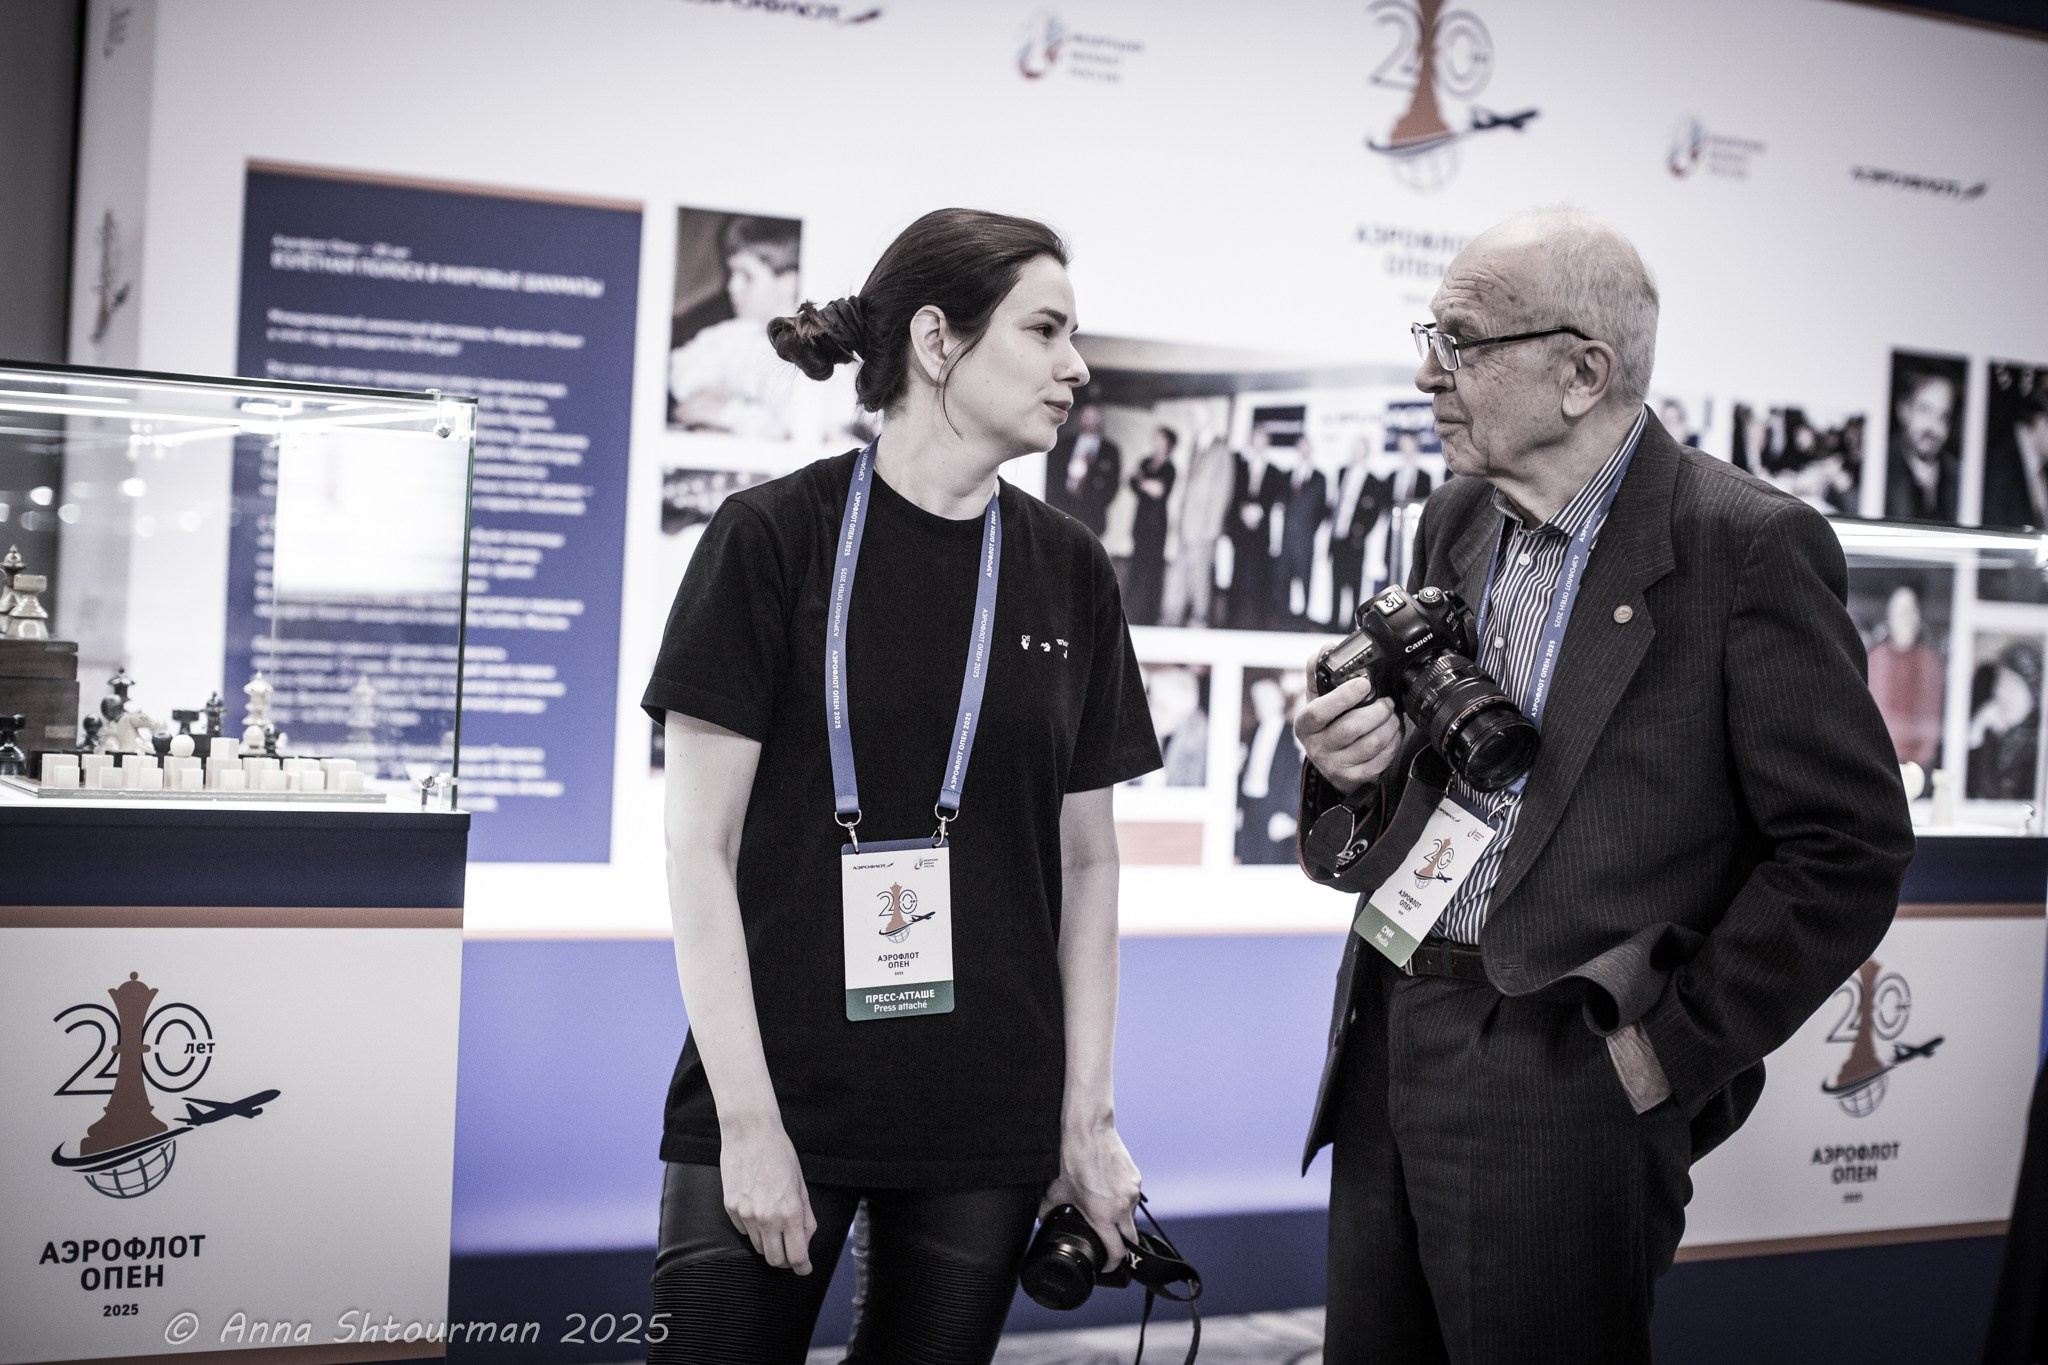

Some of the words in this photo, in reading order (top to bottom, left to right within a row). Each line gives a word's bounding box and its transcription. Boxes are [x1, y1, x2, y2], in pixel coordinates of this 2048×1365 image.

[1354, 222, 1471, 253] АЭРОФЛО
[833, 602, 842, 637] АЭРОФЛОТ
[840, 567, 848, 583] 2025
[979, 608, 988, 643] АЭРОФЛОТ
[1404, 632, 1434, 653] Canon
[1531, 679, 1546, 718] АЭРОФЛОТ
[1540, 658, 1551, 679] ОПЕН
[1546, 639, 1556, 658] 2025
[834, 711, 842, 729] 2025
[963, 712, 972, 730] 2025
[959, 730, 968, 750] ОПЕН
[950, 751, 964, 790] АЭРОФЛОТ
[877, 889, 918, 917] 20
[1398, 889, 1422, 909] АЭРОФЛОТ
[1399, 899, 1413, 912] ОПЕН
[878, 951, 920, 962] АЭРОФЛОТ
[887, 961, 910, 969] ОПЕН
[865, 989, 936, 1004] ПРЕСС-АТТАШЕ
[873, 1003, 897, 1013] Press
[897, 999, 928, 1011] attaché
[53, 1003, 213, 1096] 20
[183, 1041, 216, 1055] лет
[1810, 1142, 1901, 1166] АЭРОФЛОТ
[1831, 1165, 1879, 1185] ОПЕН
[39, 1234, 206, 1265] АЭРОФЛОТ
[80, 1264, 164, 1291] ОПЕН
[103, 1303, 139, 1317] 2025
